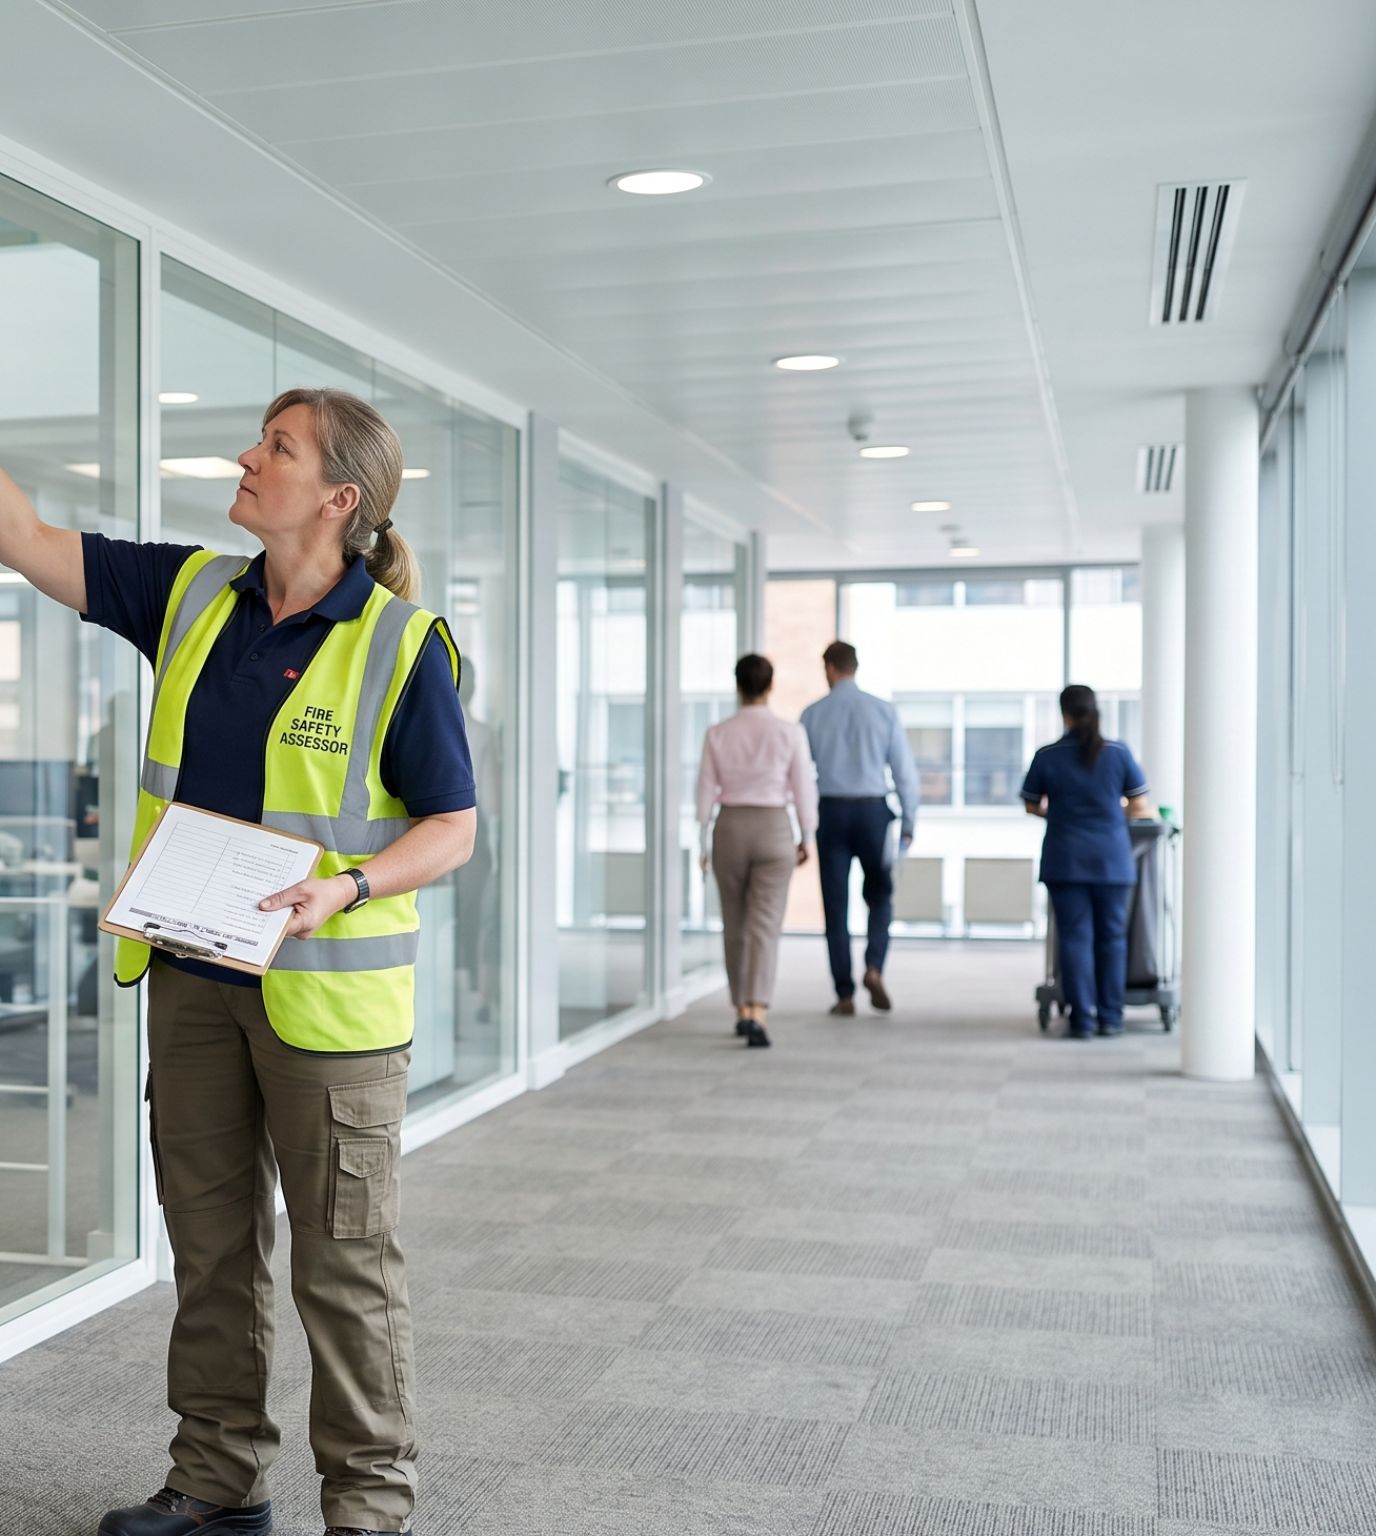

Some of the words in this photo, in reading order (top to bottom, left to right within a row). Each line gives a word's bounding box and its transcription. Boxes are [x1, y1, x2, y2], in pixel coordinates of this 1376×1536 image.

[304, 705, 334, 721] FIRE
[291, 718, 342, 738] SAFETY
[280, 732, 348, 755] ASSESSOR
